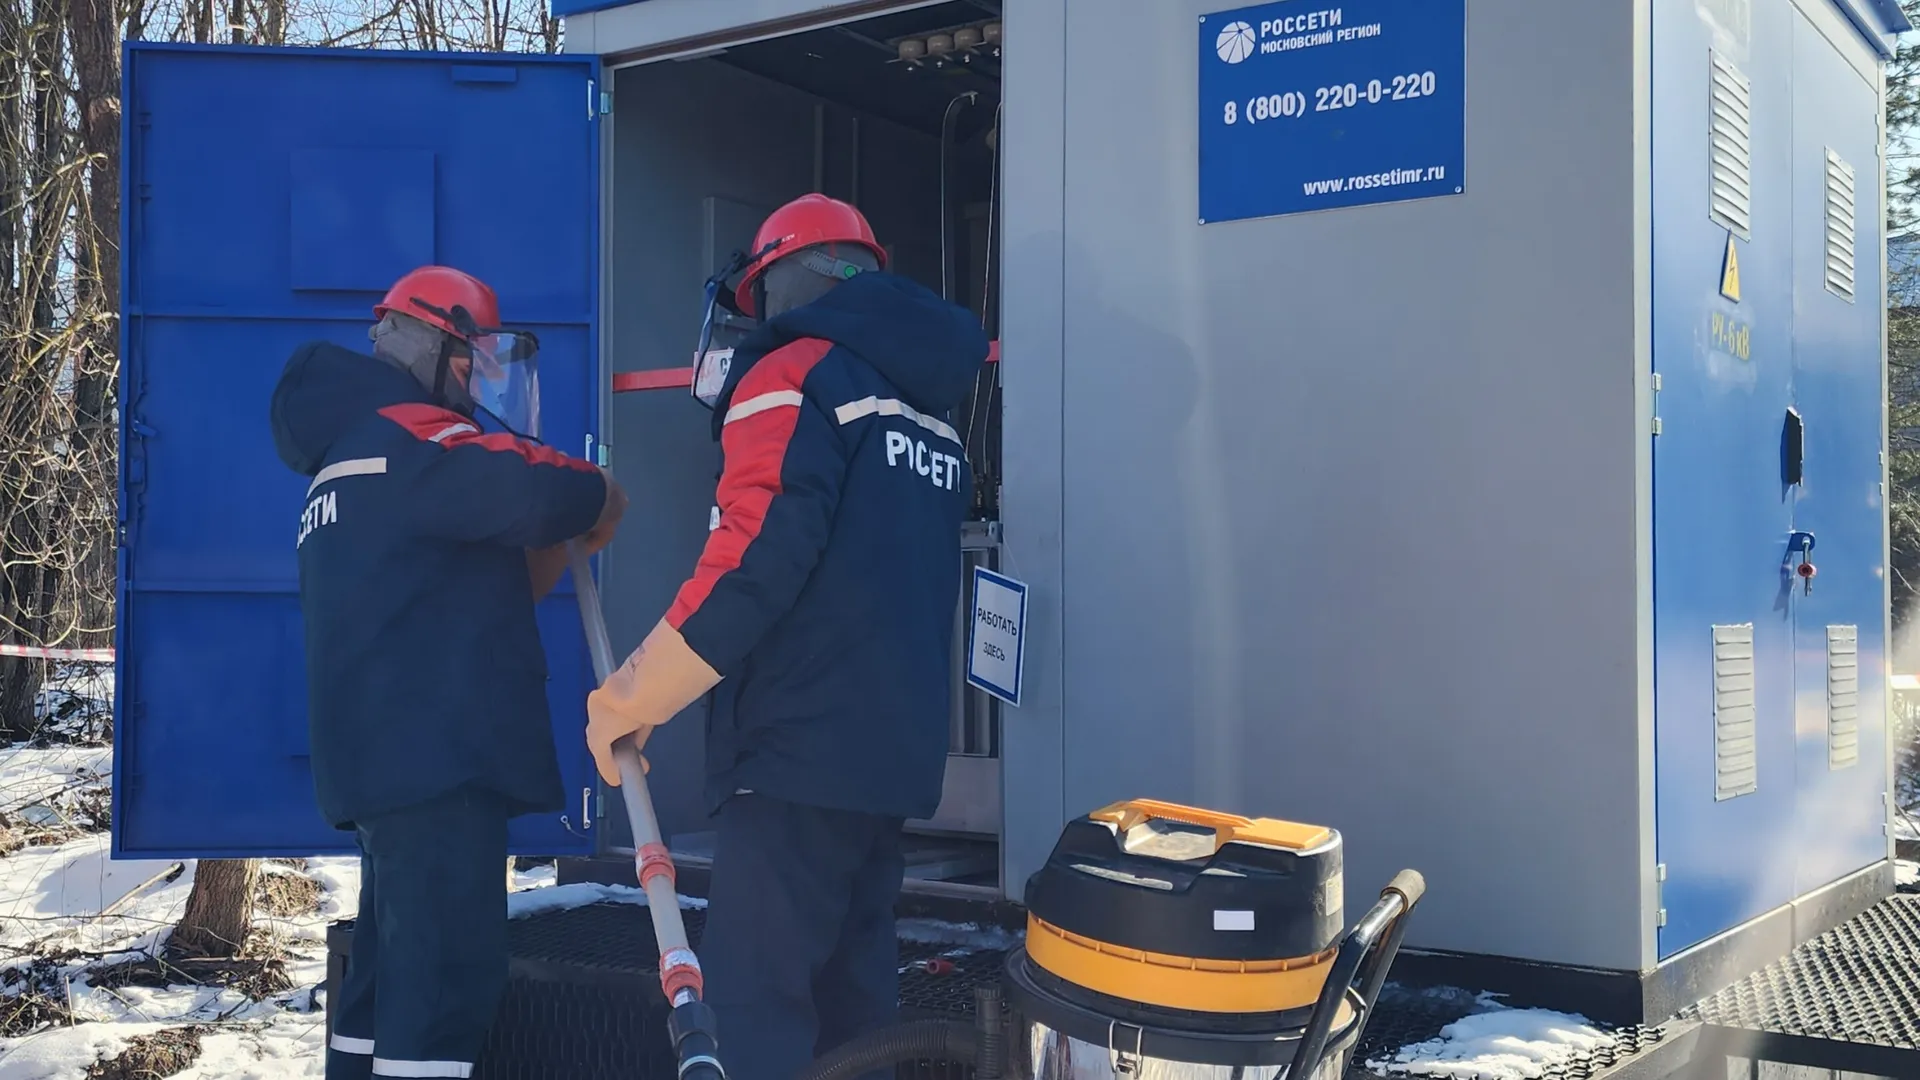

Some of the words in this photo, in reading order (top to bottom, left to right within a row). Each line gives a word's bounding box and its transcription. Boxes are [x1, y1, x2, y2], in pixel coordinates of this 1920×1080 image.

[1260, 8, 1342, 38] РОССЕТИ
[1260, 30, 1333, 54] МОСКОВСКИЙ
[1337, 23, 1381, 42] РЕГИОН
[1224, 101, 1237, 125] 8
[1246, 91, 1306, 124] (800)
[1315, 71, 1436, 112] 220-0-220
[1303, 165, 1445, 196] www.rossetimr.ru
[977, 607, 1018, 636] РАБОТАТЬ
[983, 641, 1006, 661] ЗДЕСЬ
